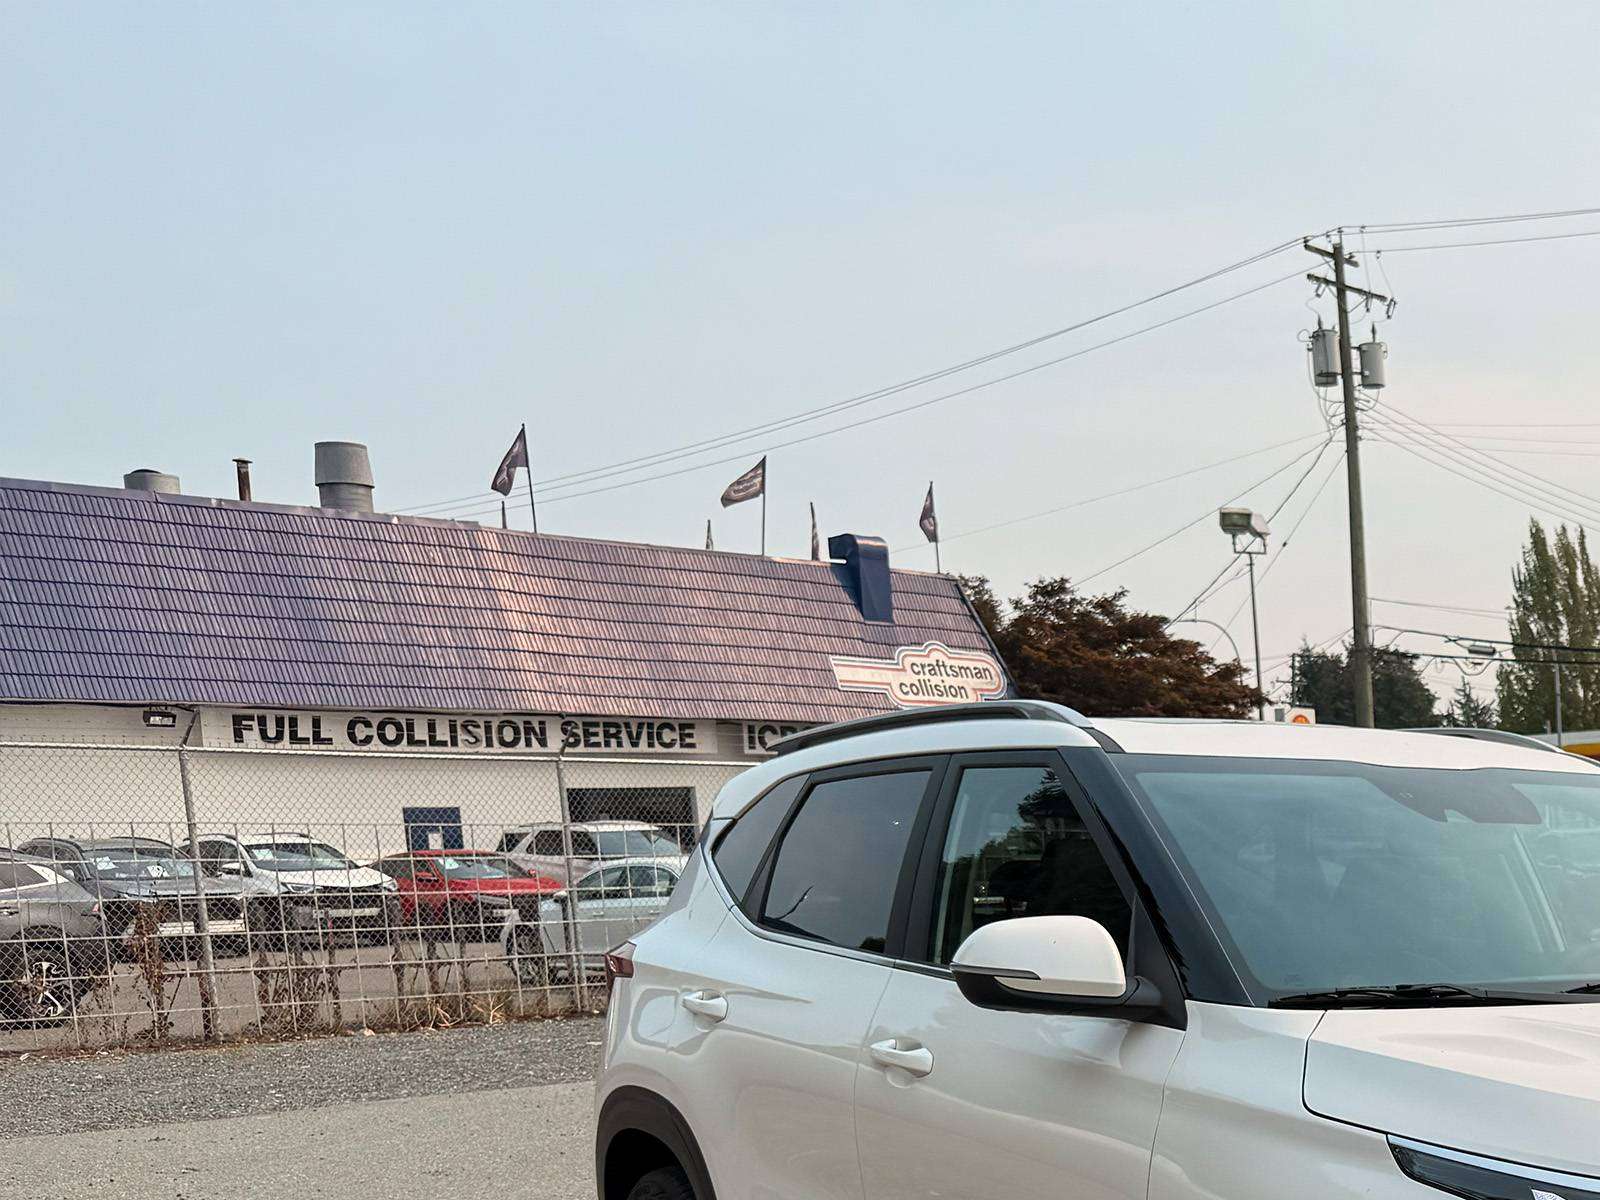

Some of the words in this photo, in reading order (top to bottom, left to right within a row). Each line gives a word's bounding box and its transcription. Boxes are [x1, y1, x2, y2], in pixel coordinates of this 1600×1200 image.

[910, 659, 994, 681] craftsman
[899, 679, 969, 699] collision
[231, 714, 333, 745] FULL
[346, 716, 548, 748] COLLISION
[560, 720, 697, 749] SERVICE
